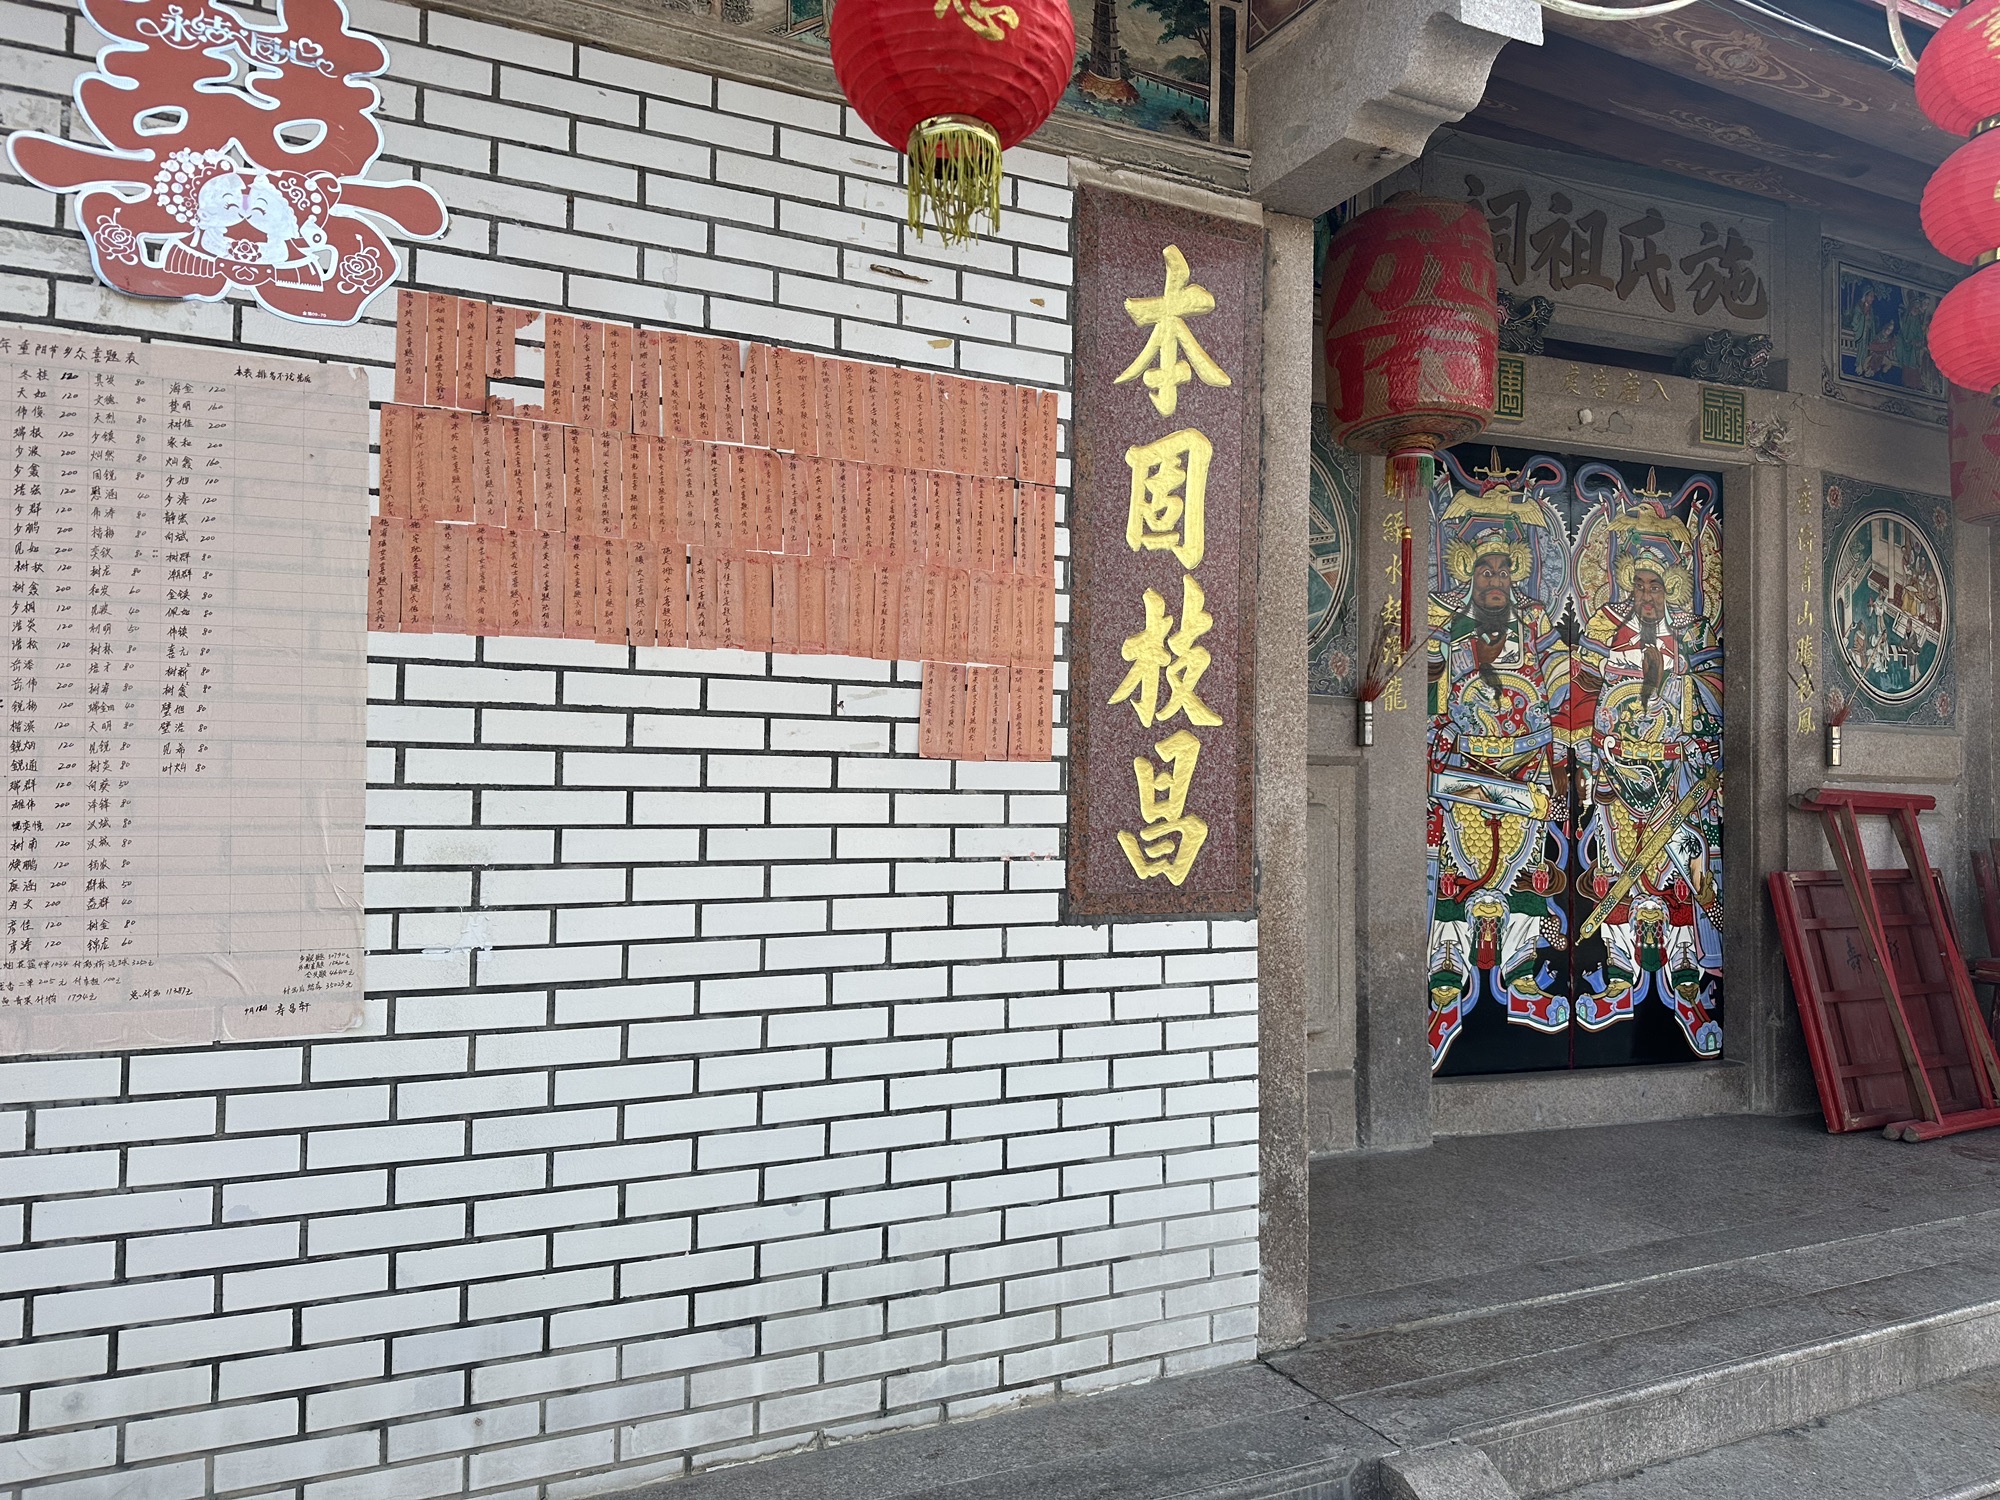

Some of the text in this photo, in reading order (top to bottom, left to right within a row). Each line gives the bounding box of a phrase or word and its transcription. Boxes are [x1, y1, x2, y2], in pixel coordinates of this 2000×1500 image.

[1465, 174, 1769, 320] 施氏祖祠
[60, 372, 79, 380] 120
[136, 396, 146, 404] 80
[136, 415, 146, 423] 80
[136, 435, 145, 444] 80
[135, 472, 144, 480] 80
[136, 511, 146, 519] 80
[135, 530, 146, 538] 80
[1108, 243, 1232, 887] 本固枝昌
[131, 568, 141, 576] 80
[203, 571, 213, 579] 80
[203, 610, 212, 618] 80
[127, 645, 136, 653] 80
[200, 648, 210, 656] 80
[201, 667, 210, 675] 80
[203, 684, 212, 693] 80
[198, 724, 208, 732] 80
[198, 744, 208, 752] 80
[120, 762, 130, 770] 80
[195, 764, 206, 772] 80
[120, 799, 131, 807] 80
[123, 818, 132, 828] 80
[122, 839, 132, 847] 80
[121, 860, 130, 868] 80
[124, 920, 135, 928] 80
